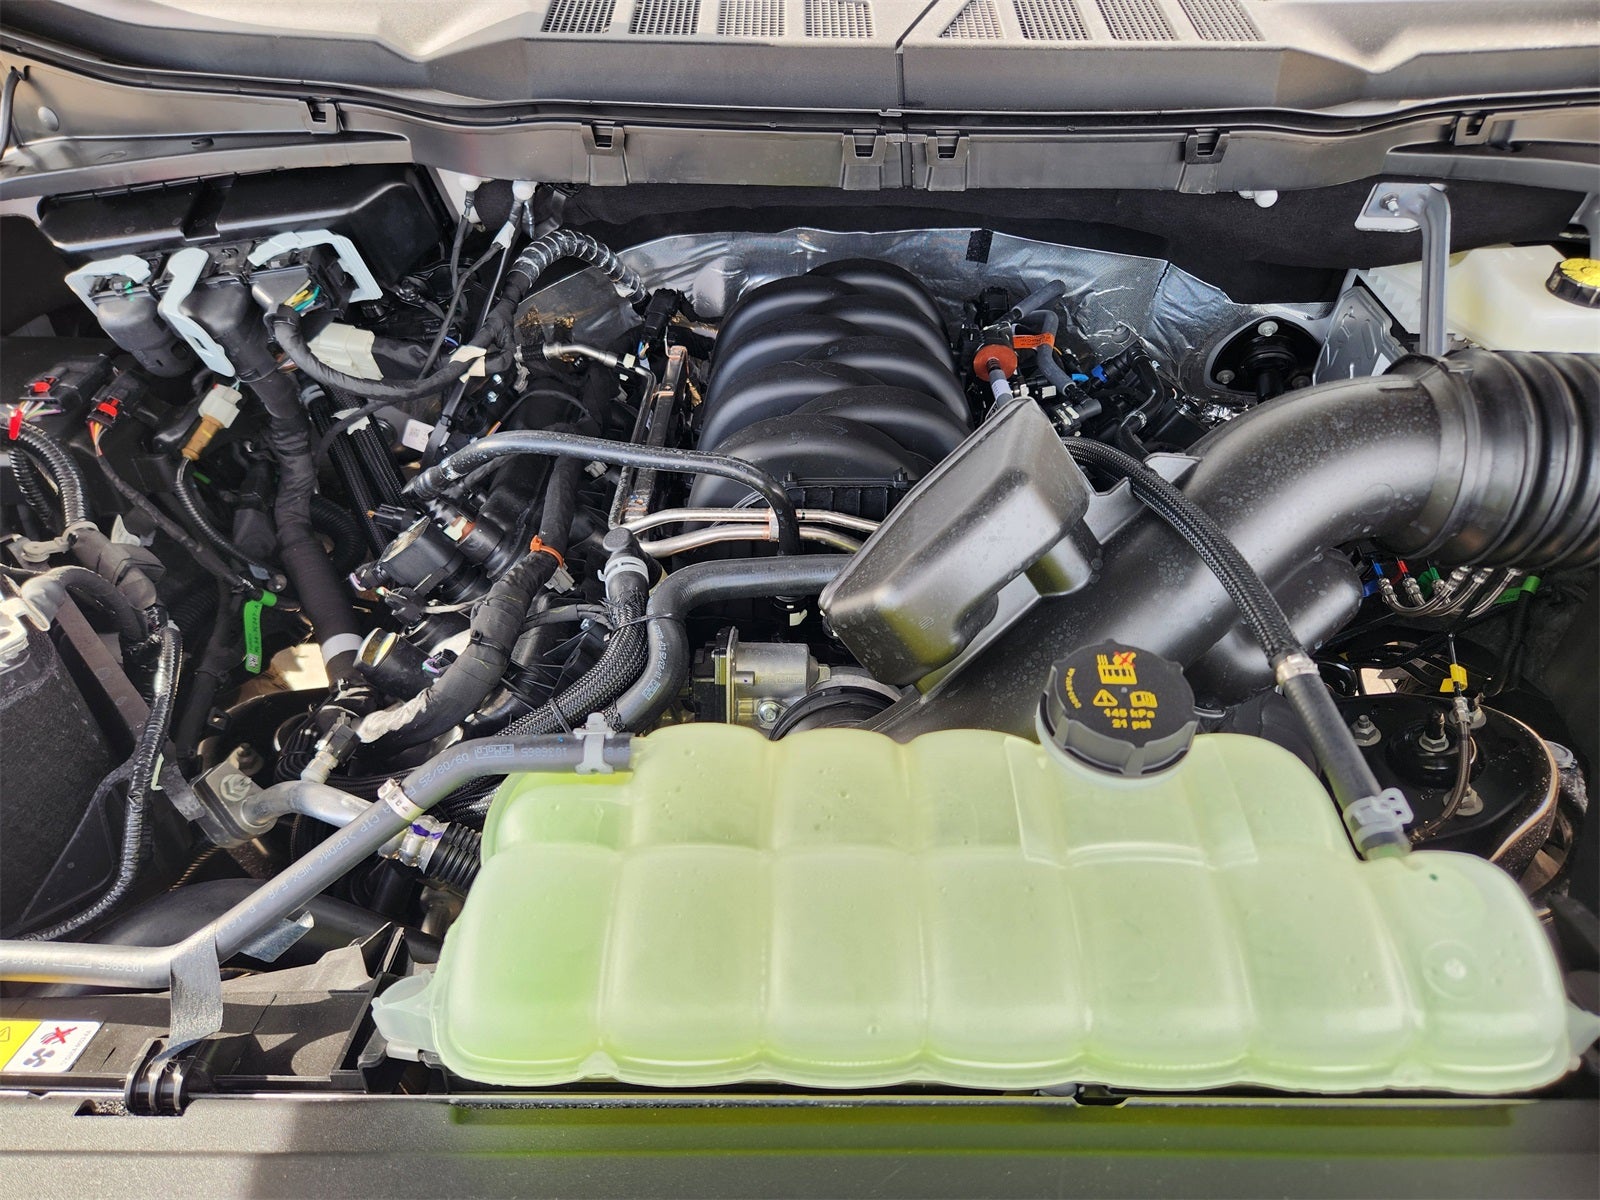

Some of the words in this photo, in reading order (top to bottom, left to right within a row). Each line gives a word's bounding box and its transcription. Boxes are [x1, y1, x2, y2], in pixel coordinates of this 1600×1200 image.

[1104, 708, 1128, 718] 145
[1130, 708, 1155, 719] kPa
[1112, 719, 1128, 728] 21
[1132, 719, 1152, 730] psi
[475, 744, 514, 758] FoMoCo
[418, 752, 470, 787] 09/08/25
[361, 814, 380, 832] CIP
